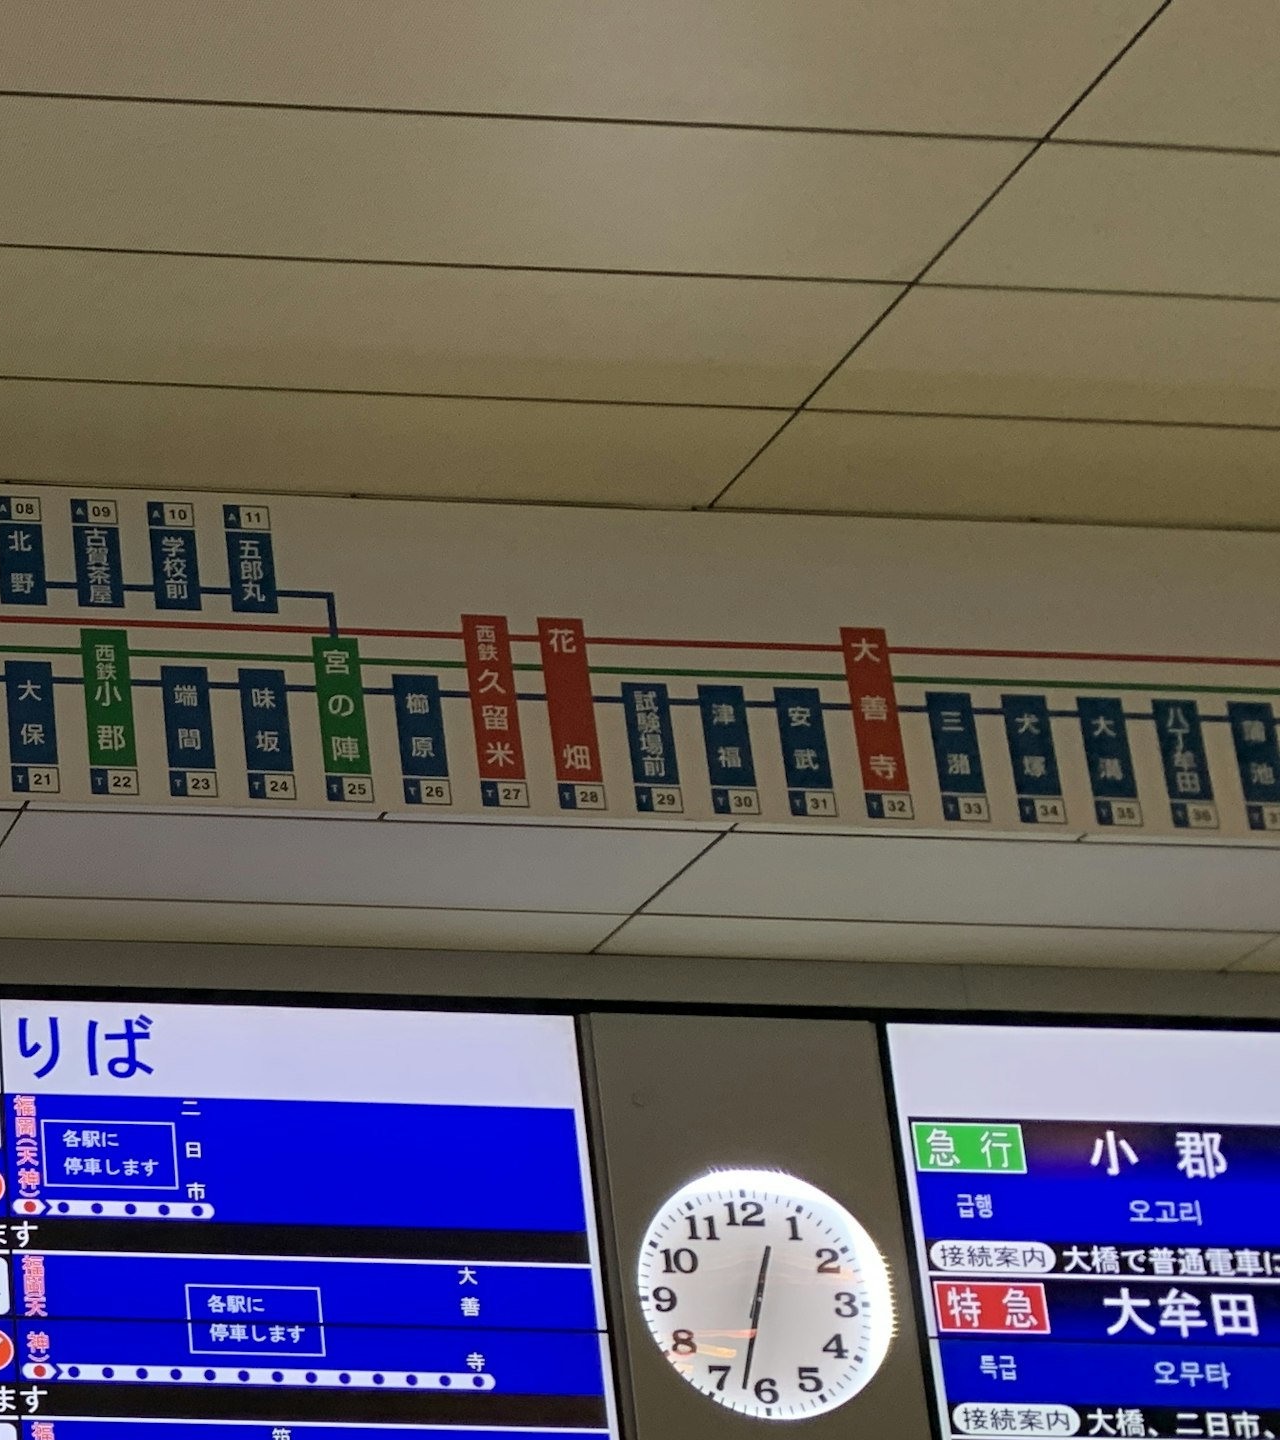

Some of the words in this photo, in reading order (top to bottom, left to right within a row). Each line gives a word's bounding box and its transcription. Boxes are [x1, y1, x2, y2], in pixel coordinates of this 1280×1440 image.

[7, 531, 36, 594] 北野
[83, 527, 115, 606] 古賀茶屋
[160, 535, 190, 601] 学校前
[94, 644, 127, 752] 西鉄小郡
[321, 647, 361, 763] 宮の陣
[475, 625, 517, 768] 西鉄久留米
[547, 627, 593, 772] 花畑
[850, 637, 898, 780] 大善寺
[61, 1128, 120, 1149] 各駅に
[925, 1127, 1013, 1169] 急行
[1089, 1129, 1229, 1180] 小郡
[62, 1156, 160, 1178] 停車します
[723, 1200, 767, 1227] 12
[955, 1193, 994, 1219] 급행
[659, 1248, 699, 1274] 10
[815, 1247, 842, 1274] 2
[939, 1242, 1047, 1270] 接続案内
[652, 1286, 678, 1313] 9
[834, 1291, 860, 1318] 3
[946, 1285, 1040, 1329] 特急
[1102, 1286, 1260, 1339] 大牟田
[753, 1377, 780, 1405] 6
[1153, 1360, 1232, 1391] 오무타
